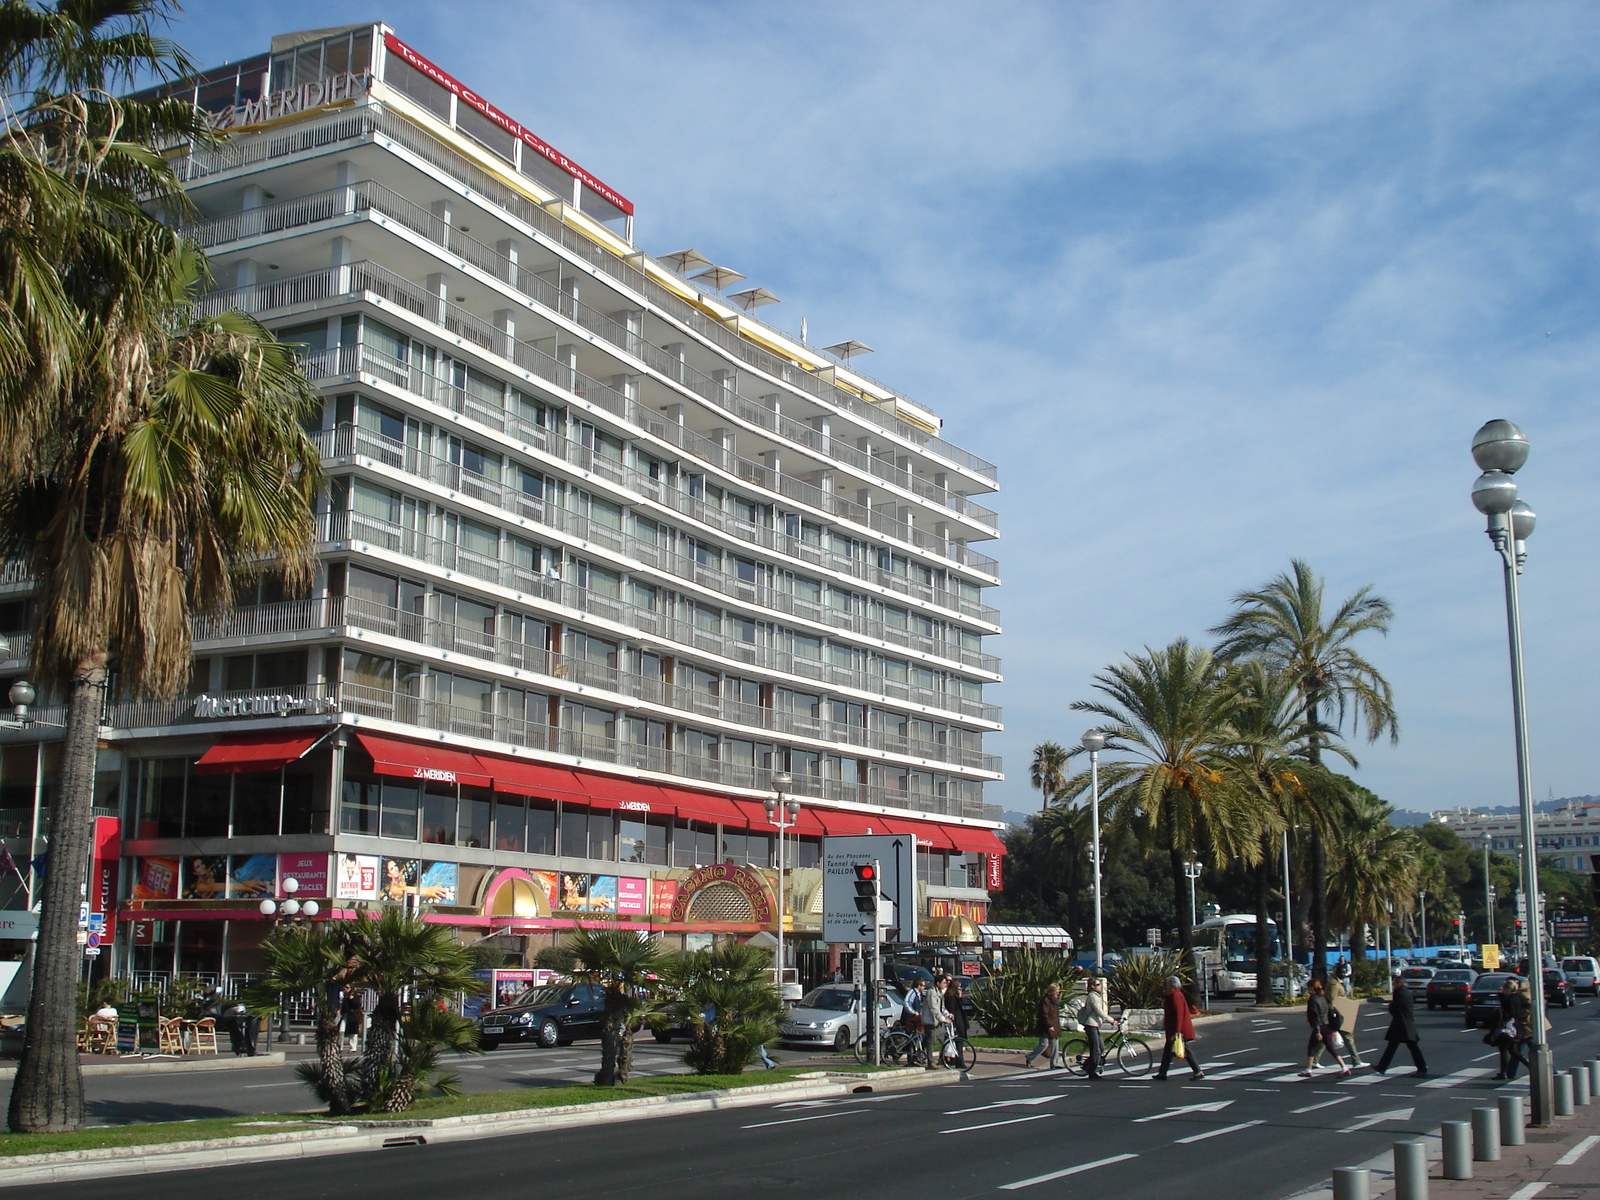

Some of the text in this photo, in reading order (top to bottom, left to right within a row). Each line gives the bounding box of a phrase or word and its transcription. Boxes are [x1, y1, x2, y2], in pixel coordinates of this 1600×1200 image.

[241, 67, 371, 127] MERIDIEN
[397, 42, 625, 207] Terrasse Colonial Café Restaurant
[413, 767, 456, 782] Le MERIDIEN
[282, 871, 327, 880] RESTAURANTS
[297, 860, 314, 868] JEUX
[672, 866, 727, 920] CASINO
[732, 869, 769, 920] RUHL
